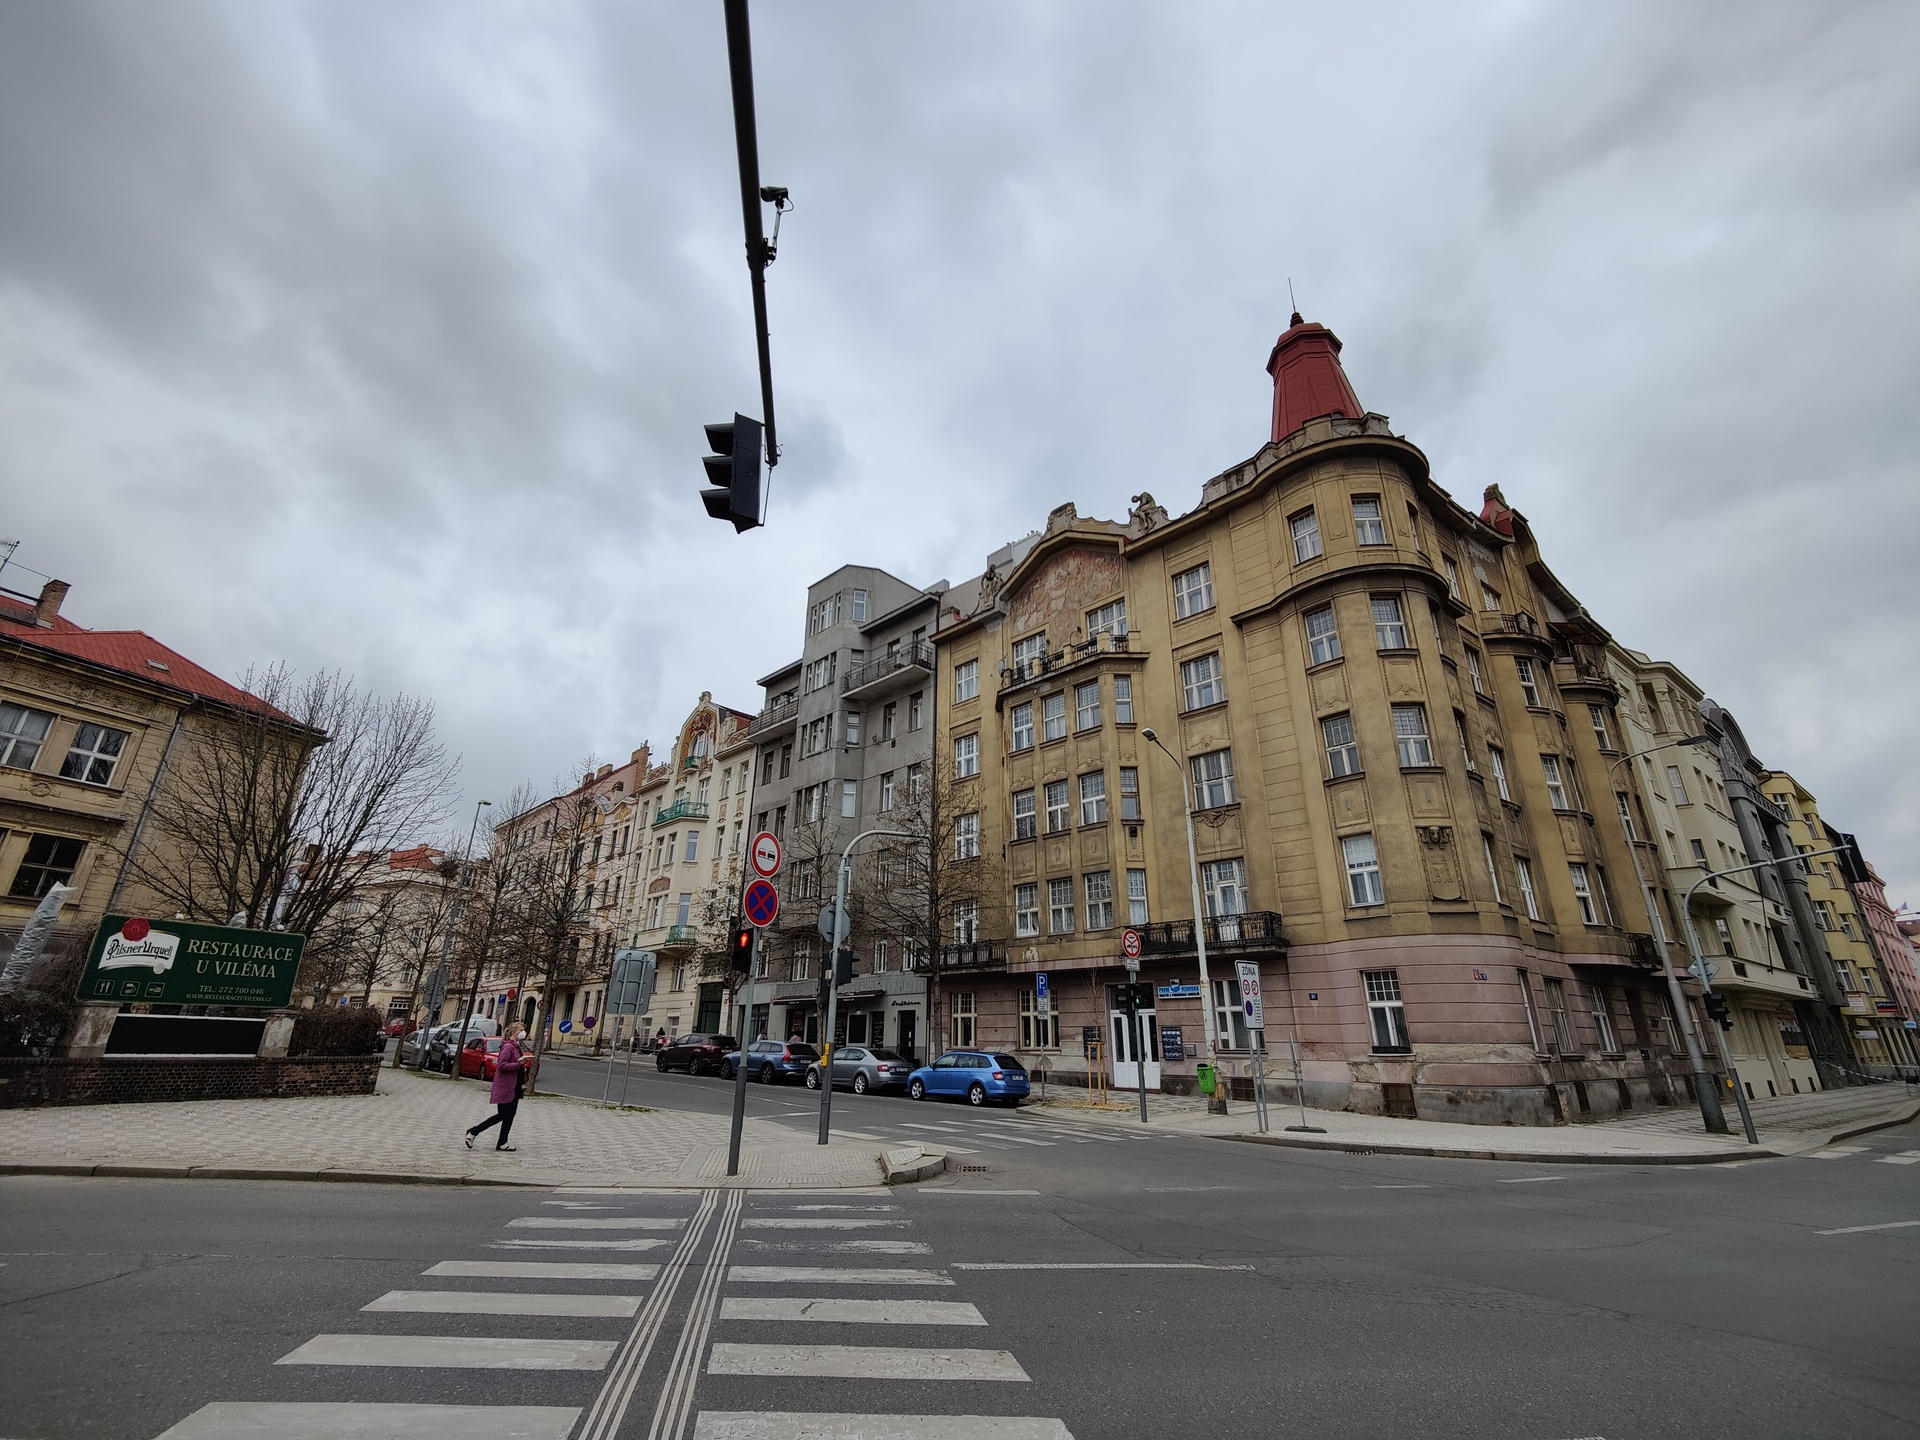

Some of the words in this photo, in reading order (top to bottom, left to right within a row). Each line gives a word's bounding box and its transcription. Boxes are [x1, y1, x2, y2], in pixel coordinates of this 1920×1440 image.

[106, 939, 144, 960] Pilsner
[143, 940, 173, 959] Urquell
[187, 939, 294, 961] RESTAURACE
[196, 960, 210, 974] U
[215, 960, 275, 978] VILÉMA
[1241, 965, 1257, 976] ZÓNA
[1039, 976, 1046, 989] P
[218, 986, 233, 994] 272
[235, 987, 250, 995] 700
